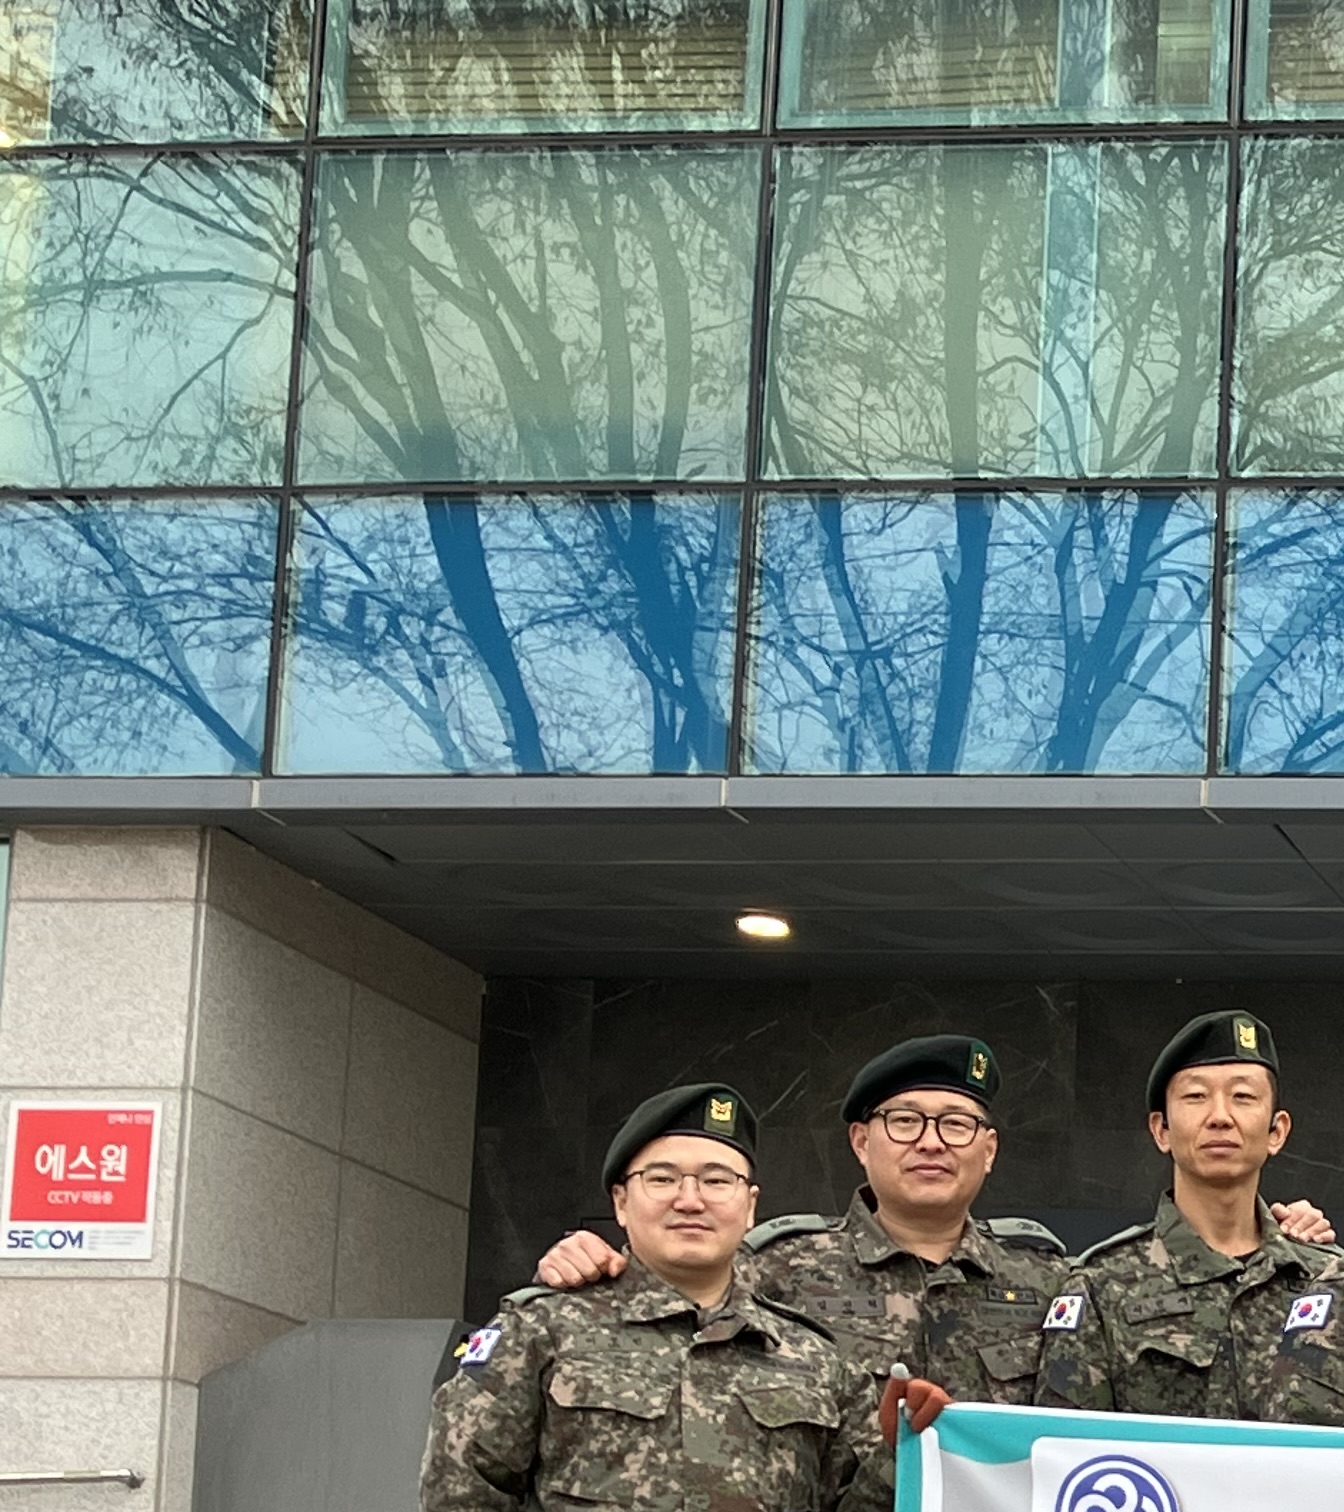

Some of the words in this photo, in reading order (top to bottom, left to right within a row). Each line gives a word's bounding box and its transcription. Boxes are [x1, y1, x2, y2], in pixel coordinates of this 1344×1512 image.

[34, 1144, 128, 1182] 에스원
[47, 1190, 80, 1205] CCTV
[6, 1229, 84, 1249] SECOM
